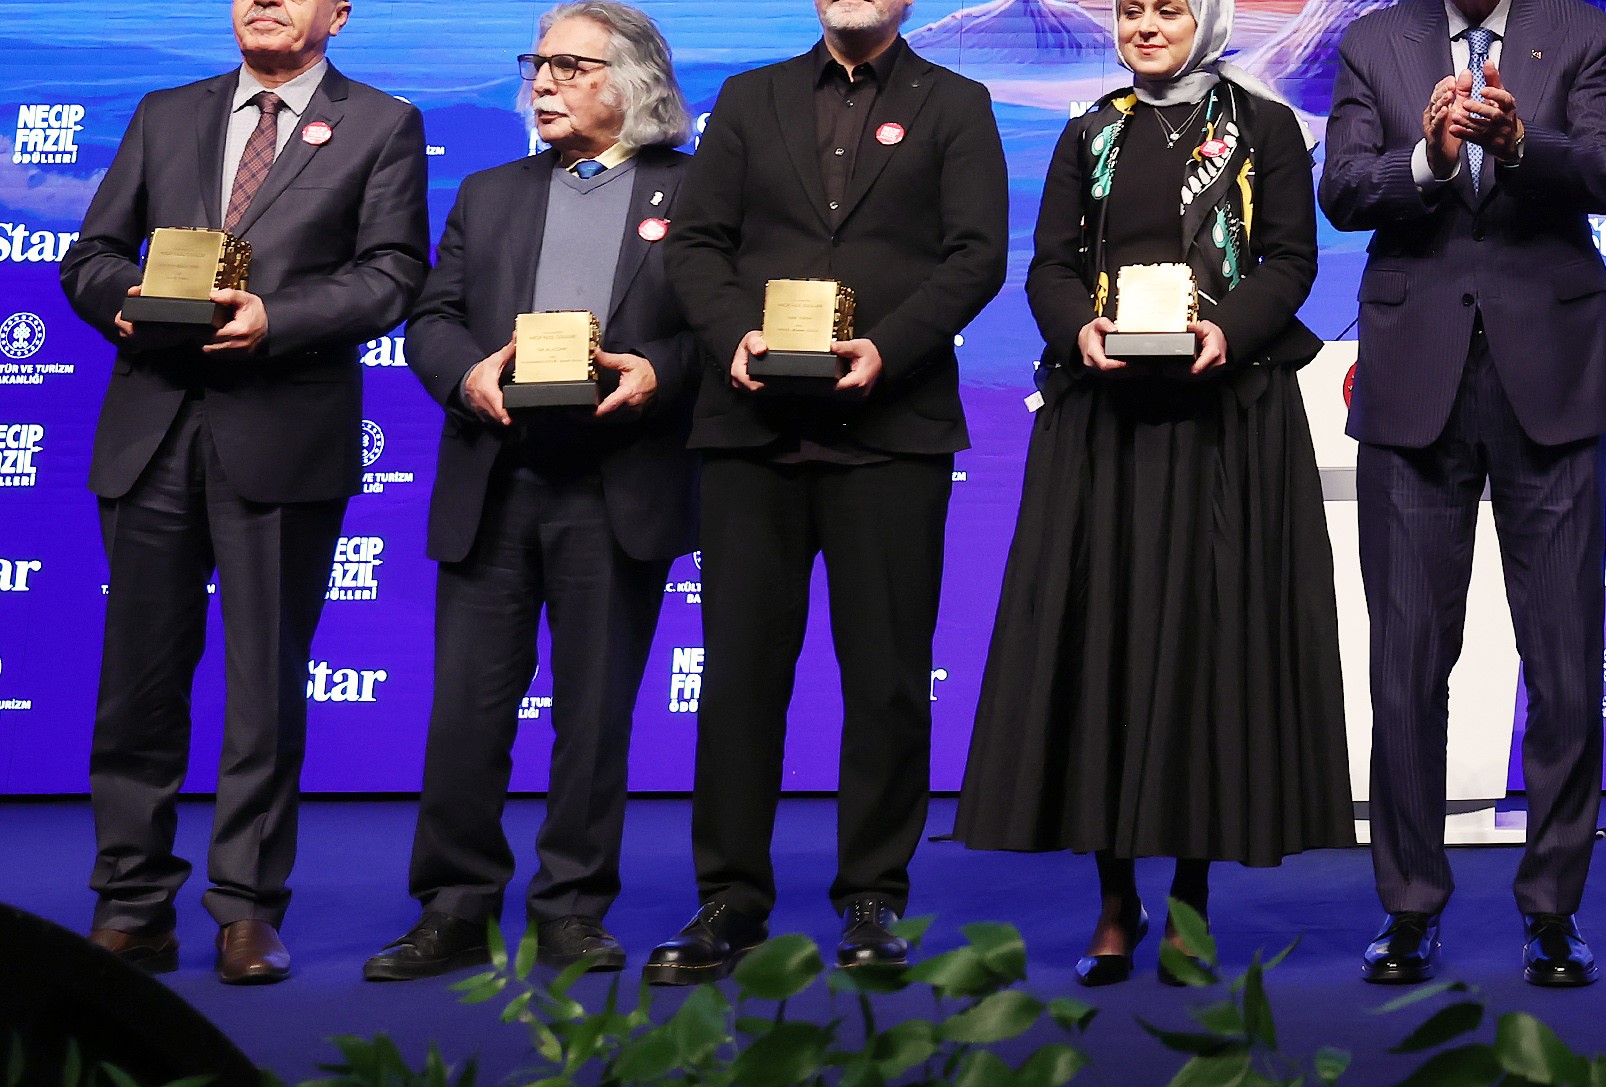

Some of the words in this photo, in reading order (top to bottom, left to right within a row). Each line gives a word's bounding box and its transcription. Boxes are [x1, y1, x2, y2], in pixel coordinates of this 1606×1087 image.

[15, 129, 78, 151] FAZIL
[20, 365, 33, 373] VE
[35, 363, 74, 373] TURİZM
[375, 471, 413, 482] TURİZM
[334, 537, 384, 562] ECİP
[328, 563, 378, 587] AZIL
[677, 581, 702, 592] KÜLT
[307, 660, 387, 702] tar
